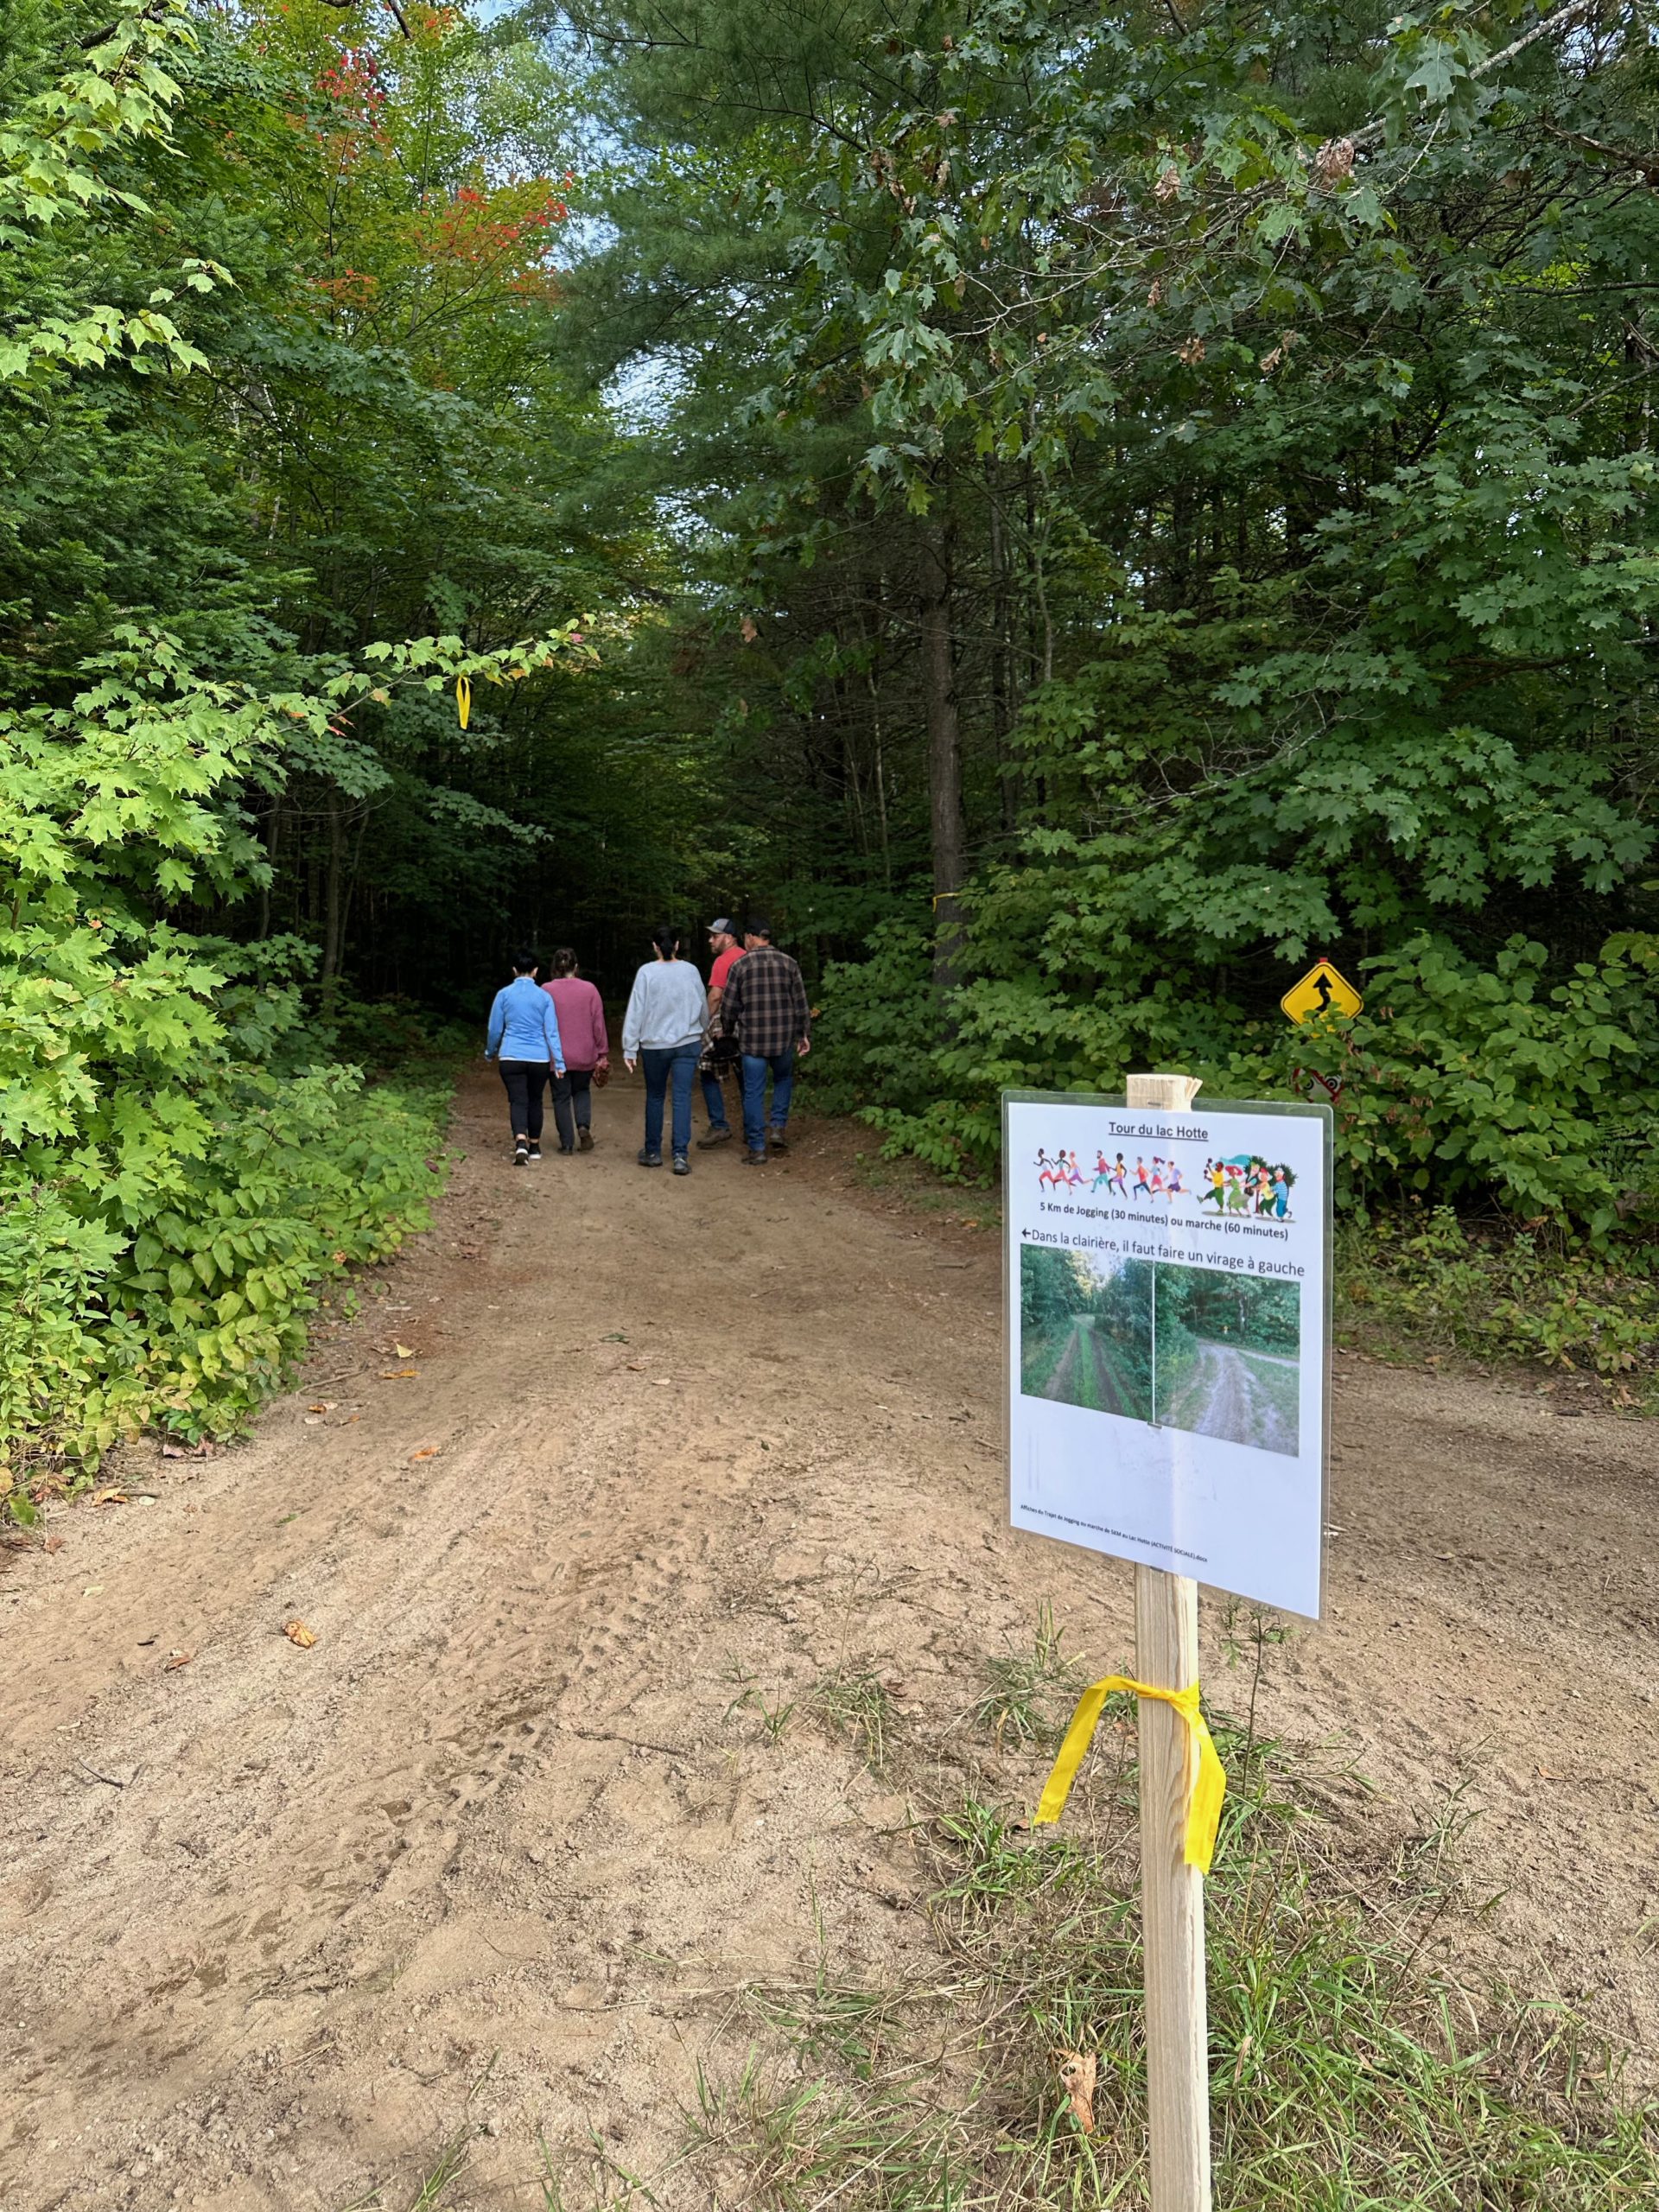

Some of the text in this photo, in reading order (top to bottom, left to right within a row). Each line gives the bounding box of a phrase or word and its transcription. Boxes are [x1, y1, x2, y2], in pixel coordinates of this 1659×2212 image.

[1109, 1122, 1208, 1139] Tour du lac Hotte
[1039, 1202, 1046, 1211] 5
[1047, 1203, 1061, 1212] Km
[1064, 1204, 1074, 1214] de
[1076, 1205, 1109, 1219] Jogging
[1111, 1209, 1125, 1220] (30
[1128, 1211, 1168, 1226] minutes)
[1185, 1219, 1222, 1231] marche
[1224, 1222, 1240, 1234] (60
[1243, 1225, 1288, 1241] minutes)
[1032, 1230, 1305, 1276] Dans la clairière, il faut faire un virage à gauche
[1064, 1516, 1079, 1526] Jogging
